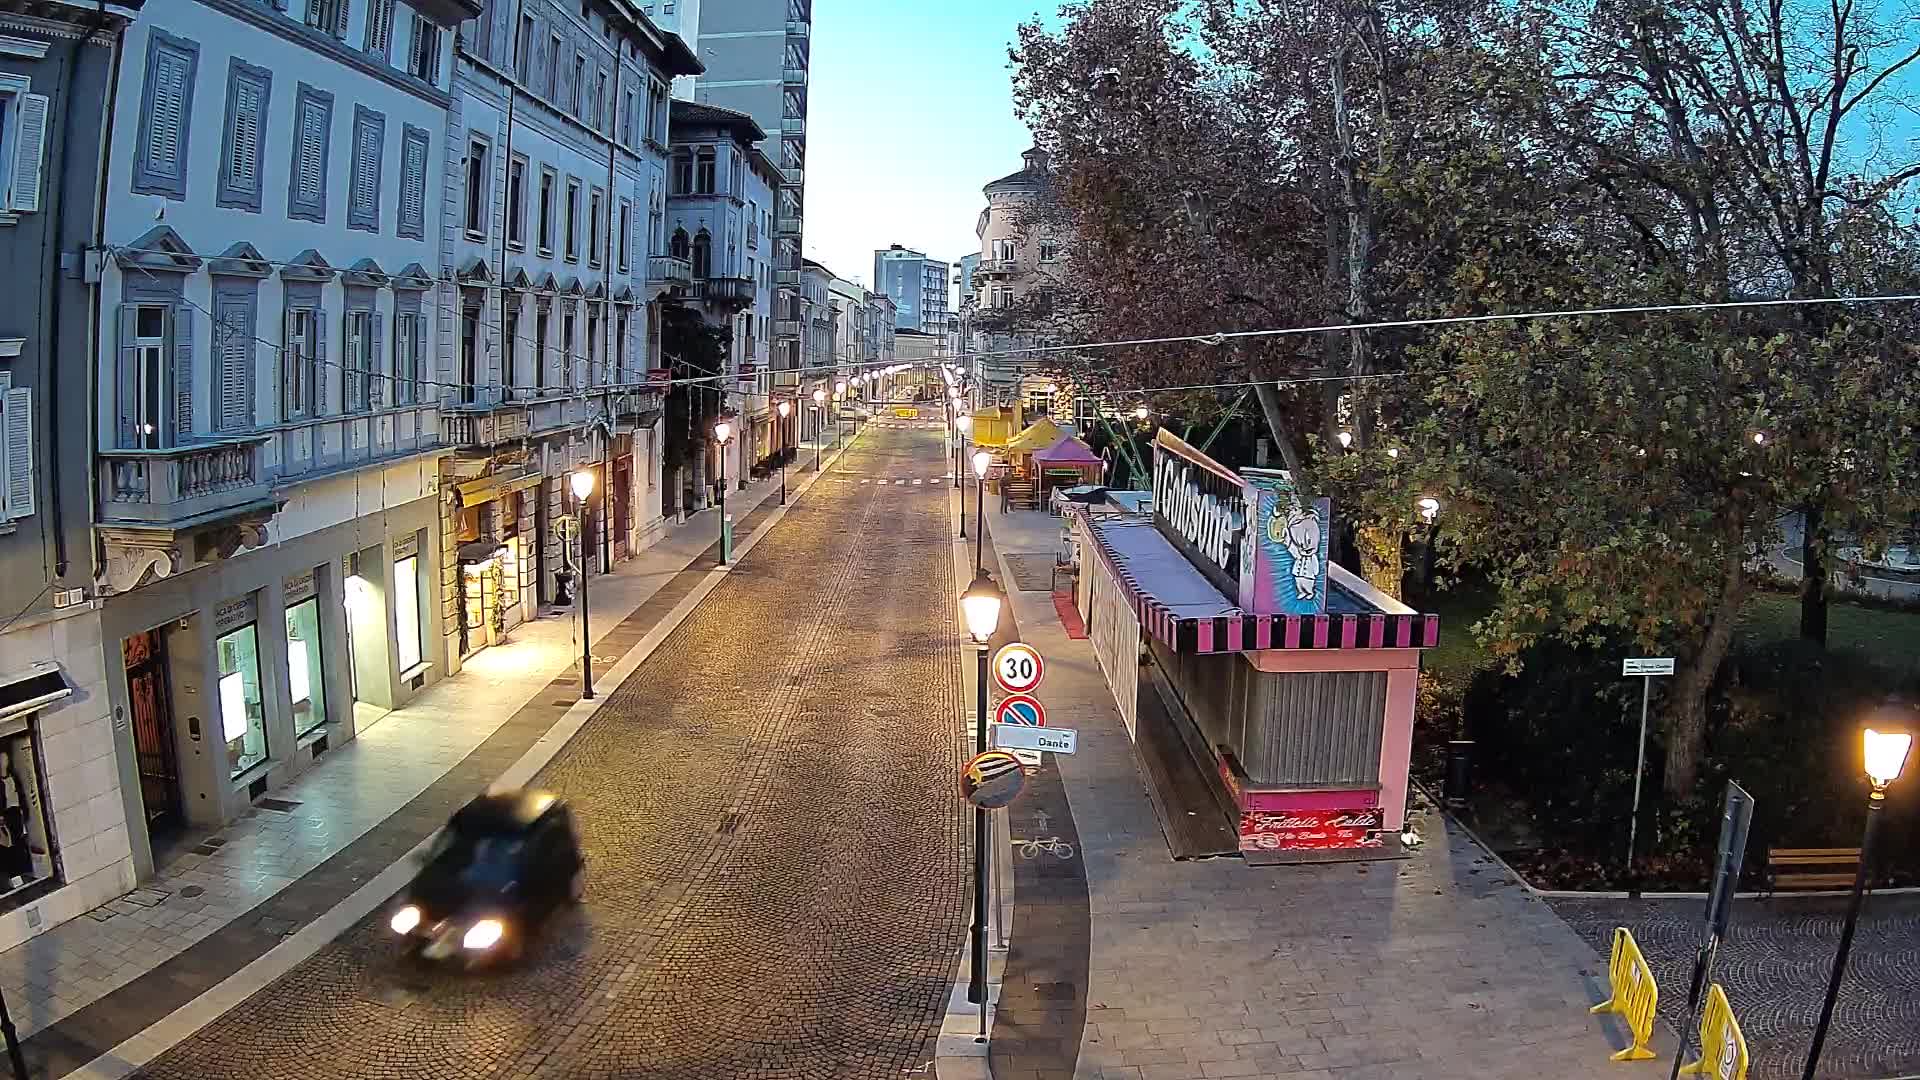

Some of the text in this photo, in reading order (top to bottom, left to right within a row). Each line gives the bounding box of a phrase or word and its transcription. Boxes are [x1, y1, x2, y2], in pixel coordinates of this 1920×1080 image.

[1162, 458, 1233, 569] Golosone
[1006, 657, 1033, 679] 30
[1038, 737, 1070, 749] Dante
